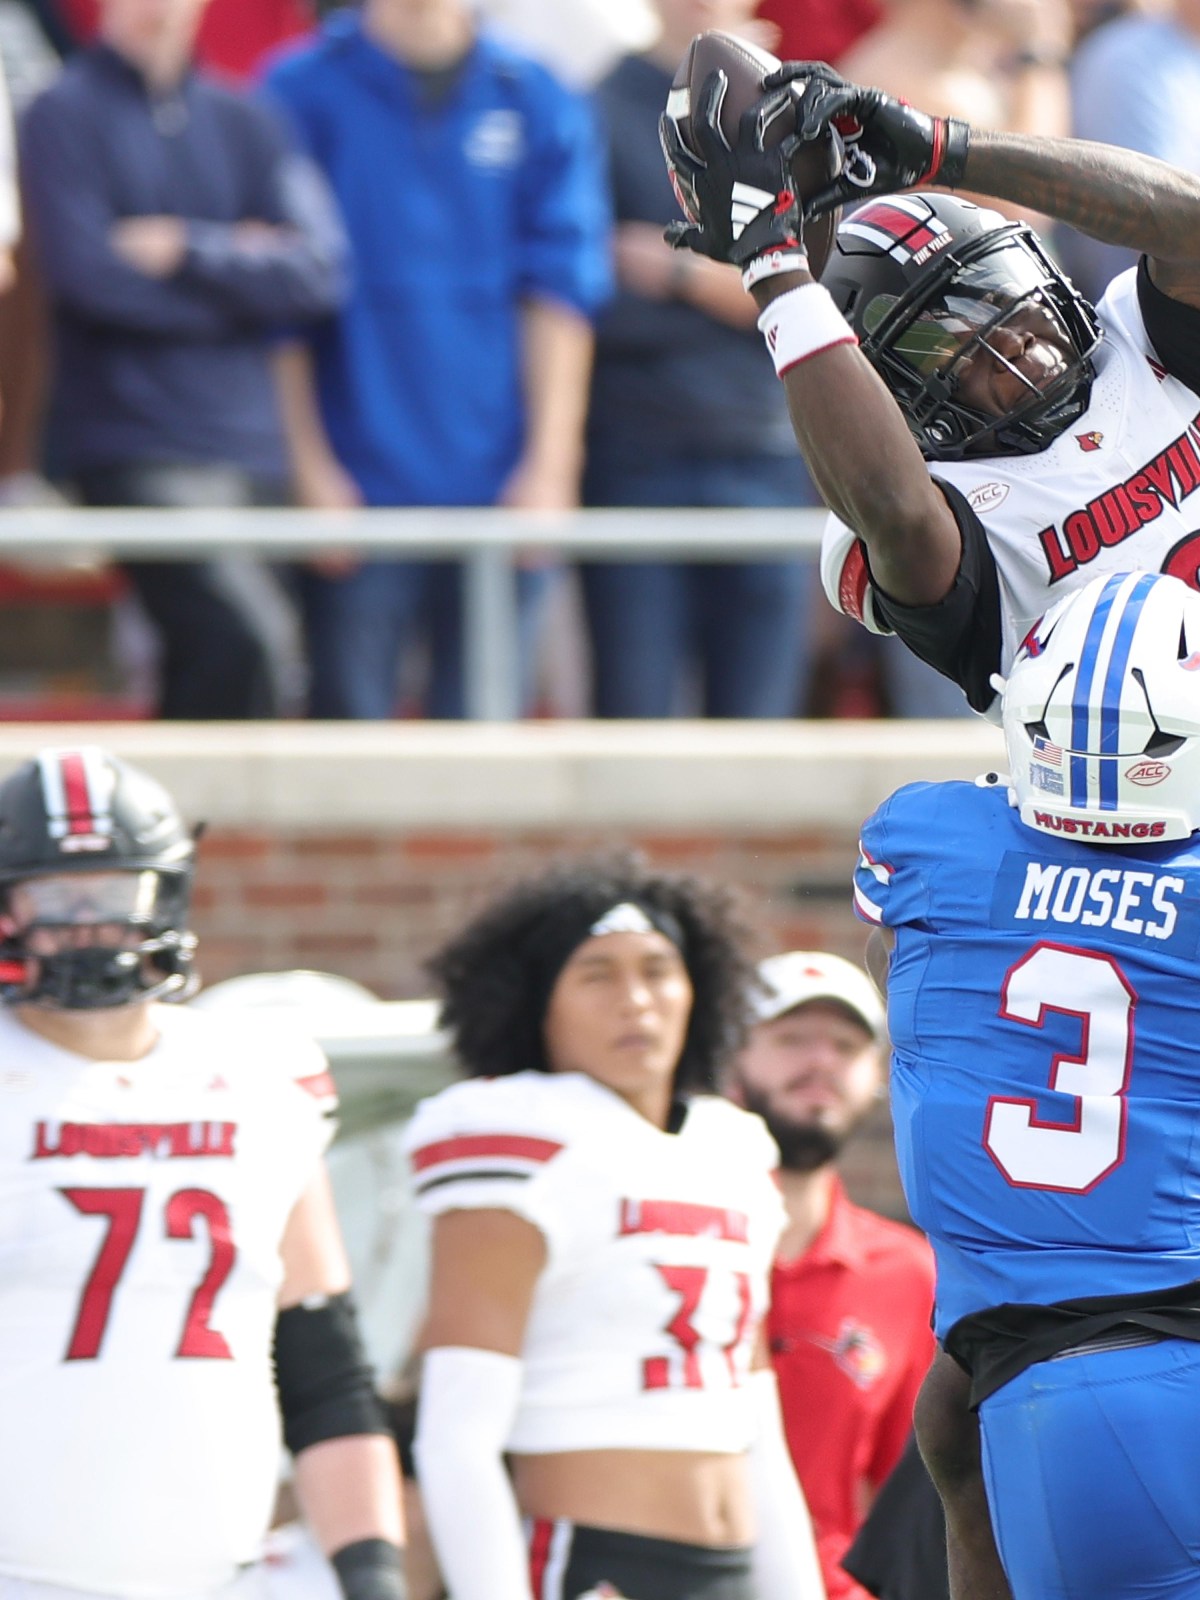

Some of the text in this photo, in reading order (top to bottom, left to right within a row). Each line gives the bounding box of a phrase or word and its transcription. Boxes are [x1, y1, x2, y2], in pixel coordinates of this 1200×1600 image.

[912, 231, 953, 265] THE VILLE
[1033, 810, 1166, 838] MUSTANGS
[1014, 862, 1185, 940] MOSES
[982, 939, 1139, 1197] 3
[53, 1186, 239, 1362] 72
